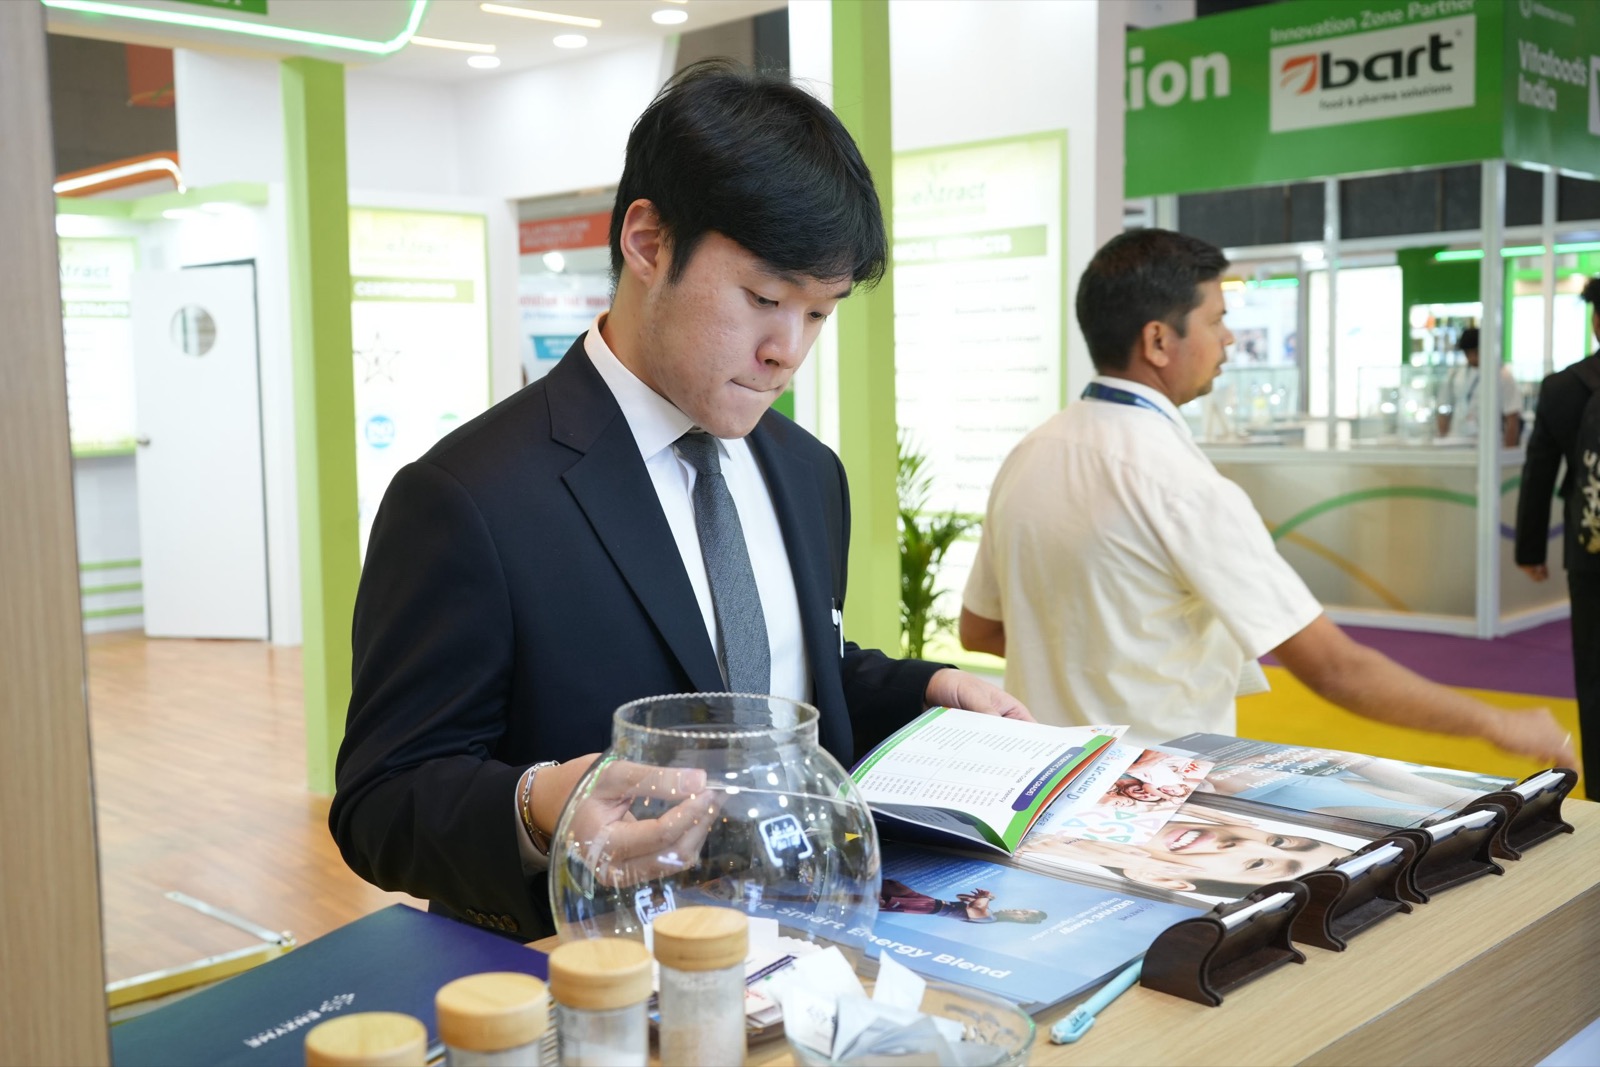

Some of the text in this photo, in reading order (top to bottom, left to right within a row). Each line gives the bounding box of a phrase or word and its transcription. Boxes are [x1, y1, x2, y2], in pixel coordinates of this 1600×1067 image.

[1270, 0, 1475, 43] Innovation Zone Partner
[1126, 46, 1230, 111] ion
[1321, 33, 1454, 90] bart
[1518, 39, 1587, 87] Vitafoods
[1518, 72, 1557, 112] India
[775, 907, 846, 930] Smart
[846, 926, 932, 958] Energy
[932, 953, 1013, 980] Blend
